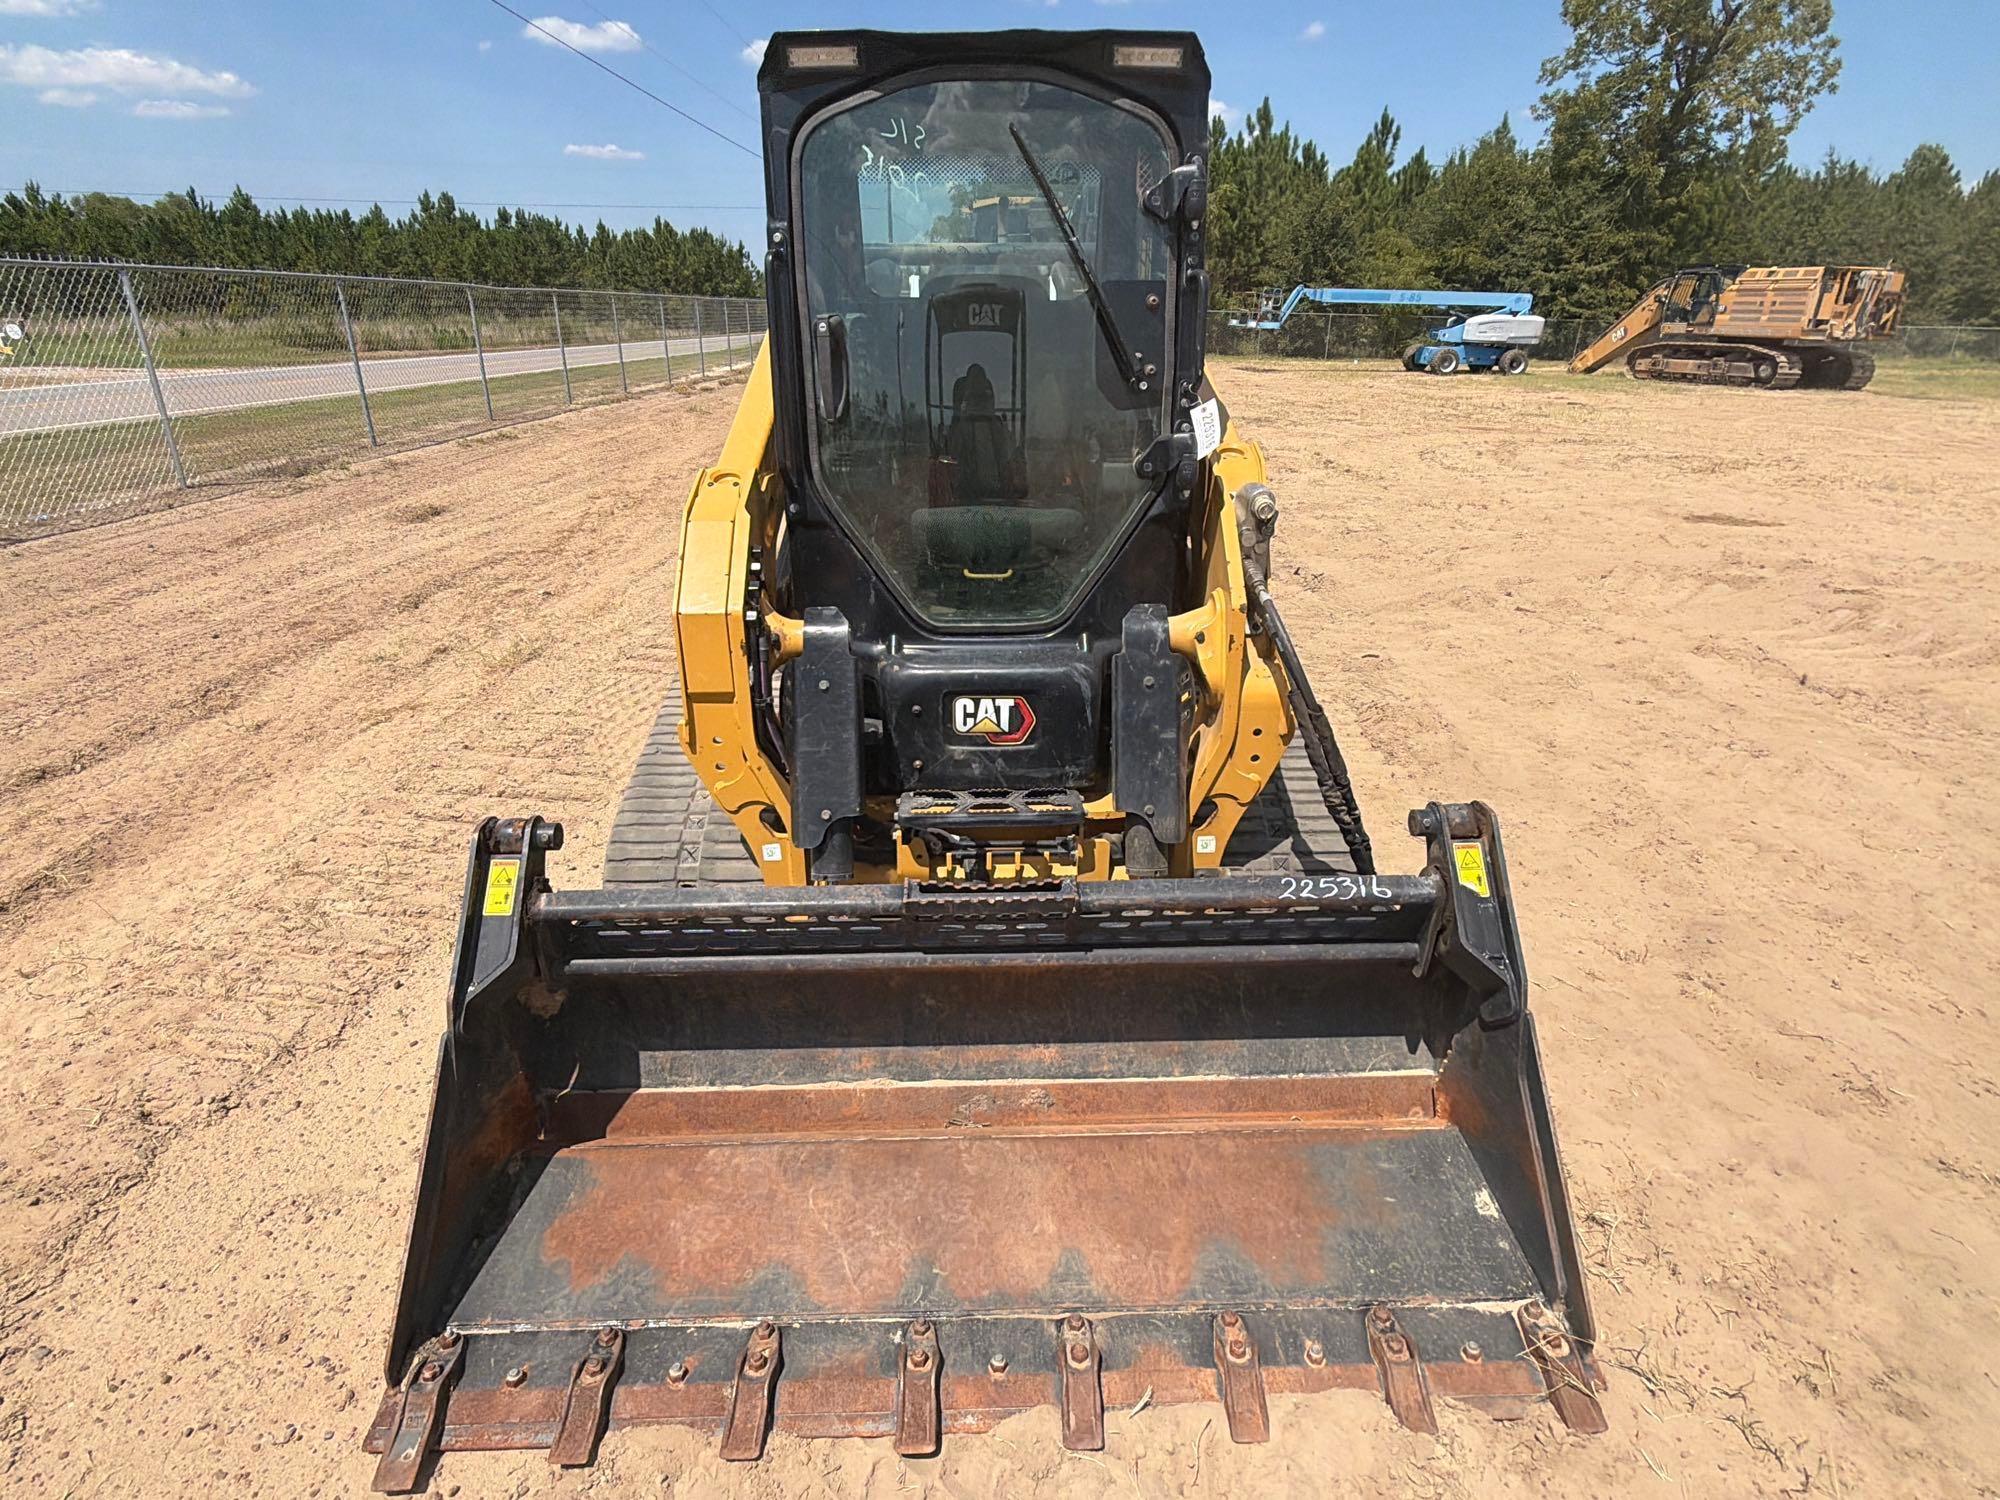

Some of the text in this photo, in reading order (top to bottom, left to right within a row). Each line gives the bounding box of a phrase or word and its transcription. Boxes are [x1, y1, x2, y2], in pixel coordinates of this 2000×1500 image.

[969, 303, 1003, 326] CAT
[1612, 327, 1626, 342] CAT
[955, 698, 1015, 733] CAT
[1278, 875, 1392, 900] 225316
